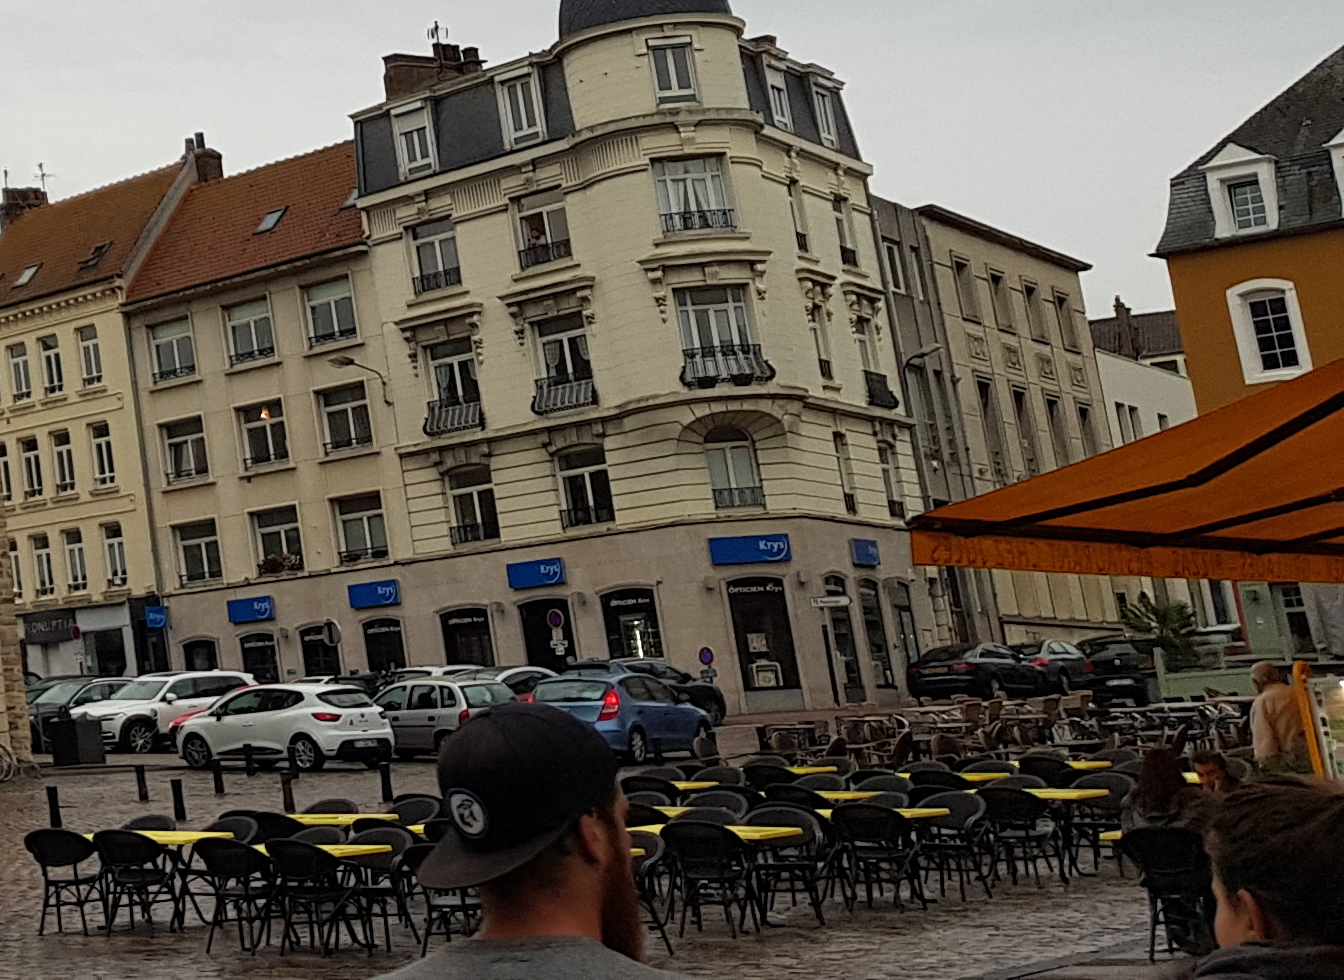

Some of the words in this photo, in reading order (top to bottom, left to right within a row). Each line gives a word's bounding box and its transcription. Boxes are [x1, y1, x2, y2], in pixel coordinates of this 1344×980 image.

[758, 539, 785, 553] Krys
[540, 563, 559, 576] Krys
[377, 585, 394, 597] Krys
[253, 601, 269, 612] Krys
